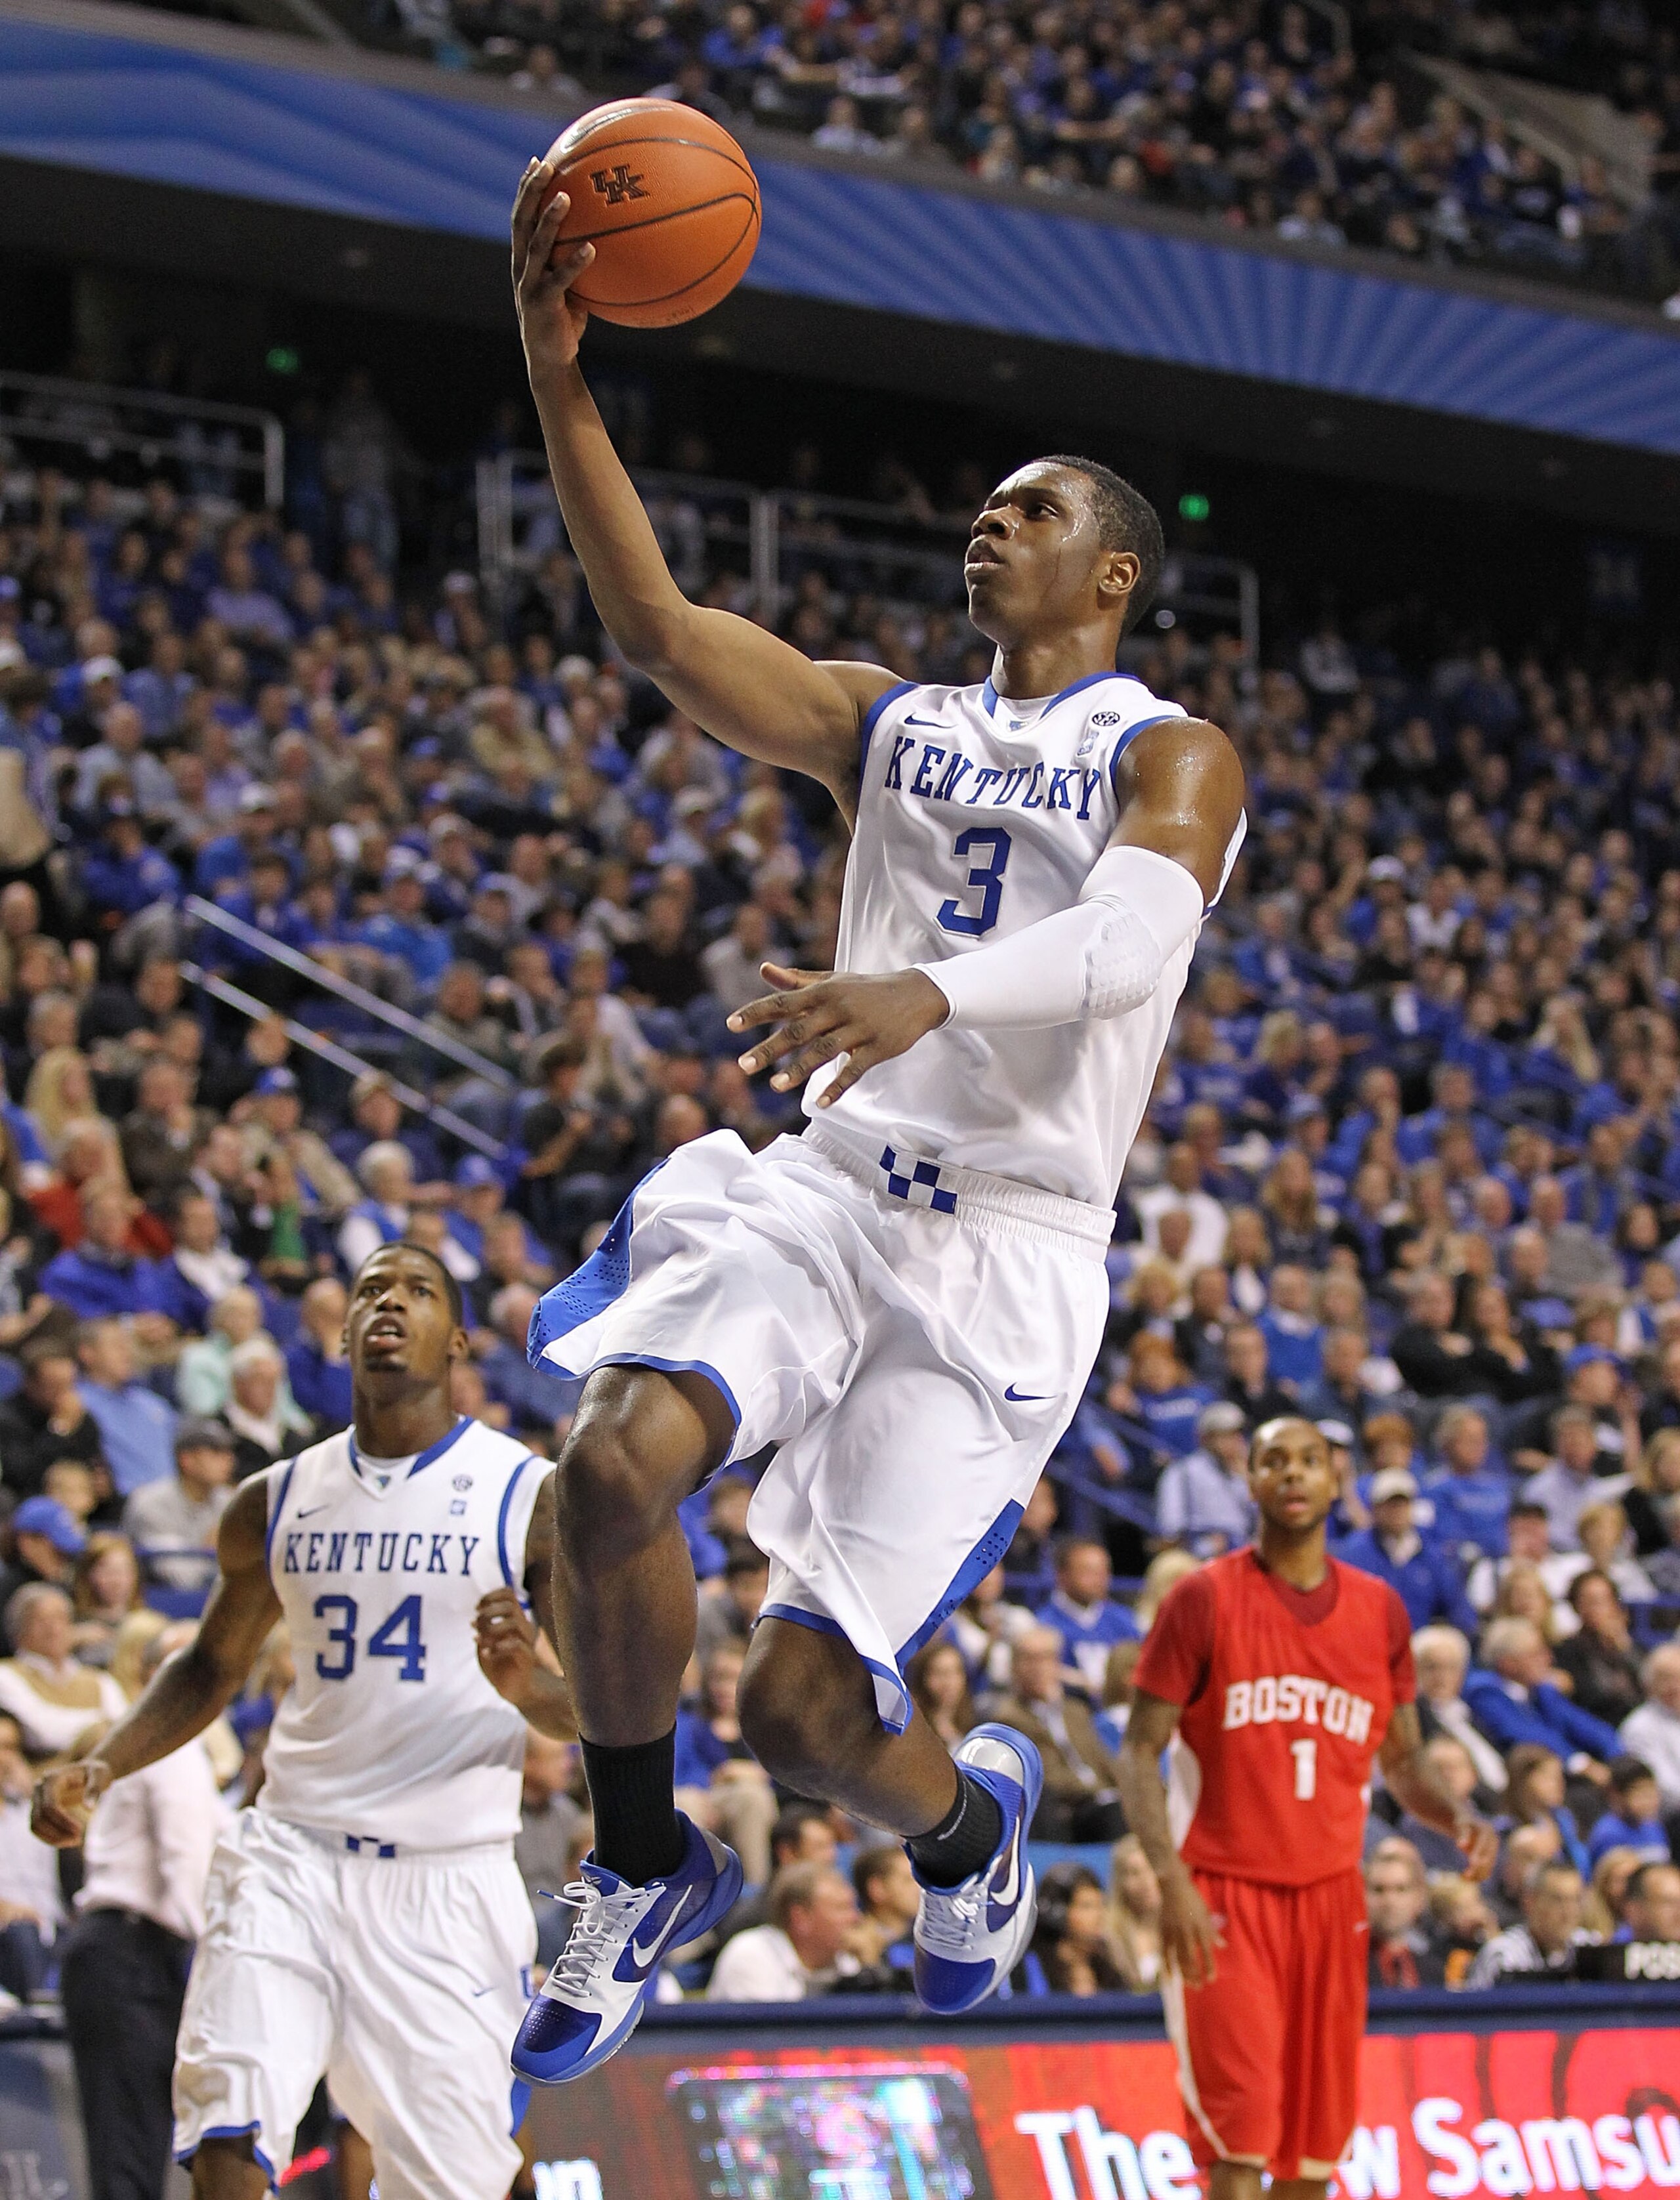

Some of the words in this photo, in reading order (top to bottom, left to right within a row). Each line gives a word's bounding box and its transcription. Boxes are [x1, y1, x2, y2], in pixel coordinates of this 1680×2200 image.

[884, 736, 1101, 820] KENTUCKY
[935, 826, 1013, 936] 3
[284, 1532, 480, 1576] KENTUCKY
[314, 1595, 427, 1682] 34
[1223, 1674, 1376, 1746] BOSTON
[1291, 1739, 1318, 1798] 1
[1014, 2105, 1202, 2200] The
[1411, 2097, 1680, 2199] Samsu
